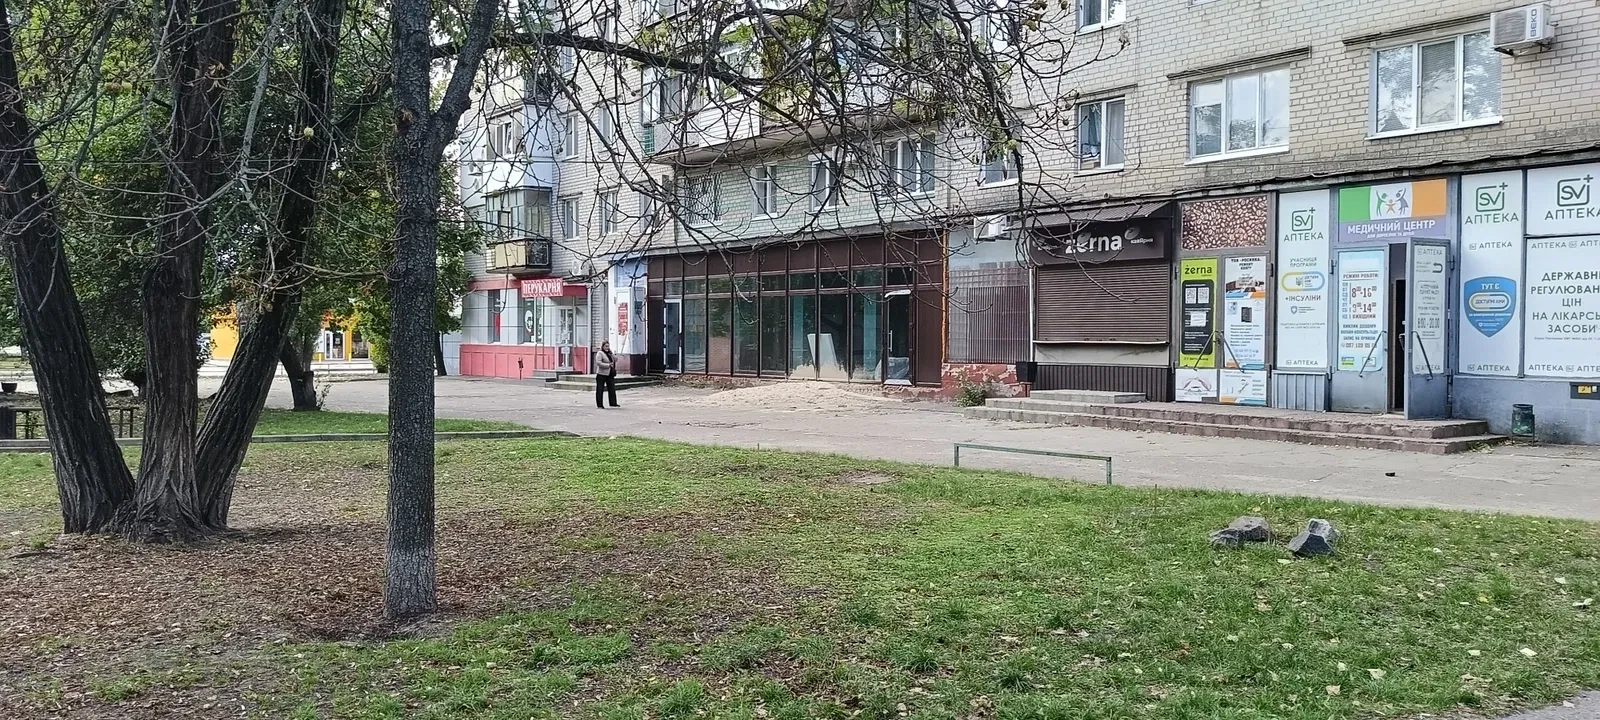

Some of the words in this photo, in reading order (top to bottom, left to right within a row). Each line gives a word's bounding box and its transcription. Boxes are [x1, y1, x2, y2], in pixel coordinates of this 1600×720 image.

[1465, 212, 1519, 225] АПТЕКА
[1347, 221, 1400, 234] МЕДИЧНИЙ
[1403, 219, 1435, 231] ЦЕНТР
[1284, 232, 1324, 242] АПТЕКА
[1479, 241, 1513, 250] АПТЕКА
[1531, 241, 1567, 250] АПТЕКА
[1580, 239, 1600, 248] АПТ
[1184, 264, 1212, 275] żerna
[523, 282, 561, 294] ПЕРУКАРНЯ
[1562, 297, 1582, 308] ЦІН
[1532, 312, 1548, 321] НА
[1547, 324, 1596, 333] ЗАСОБИ
